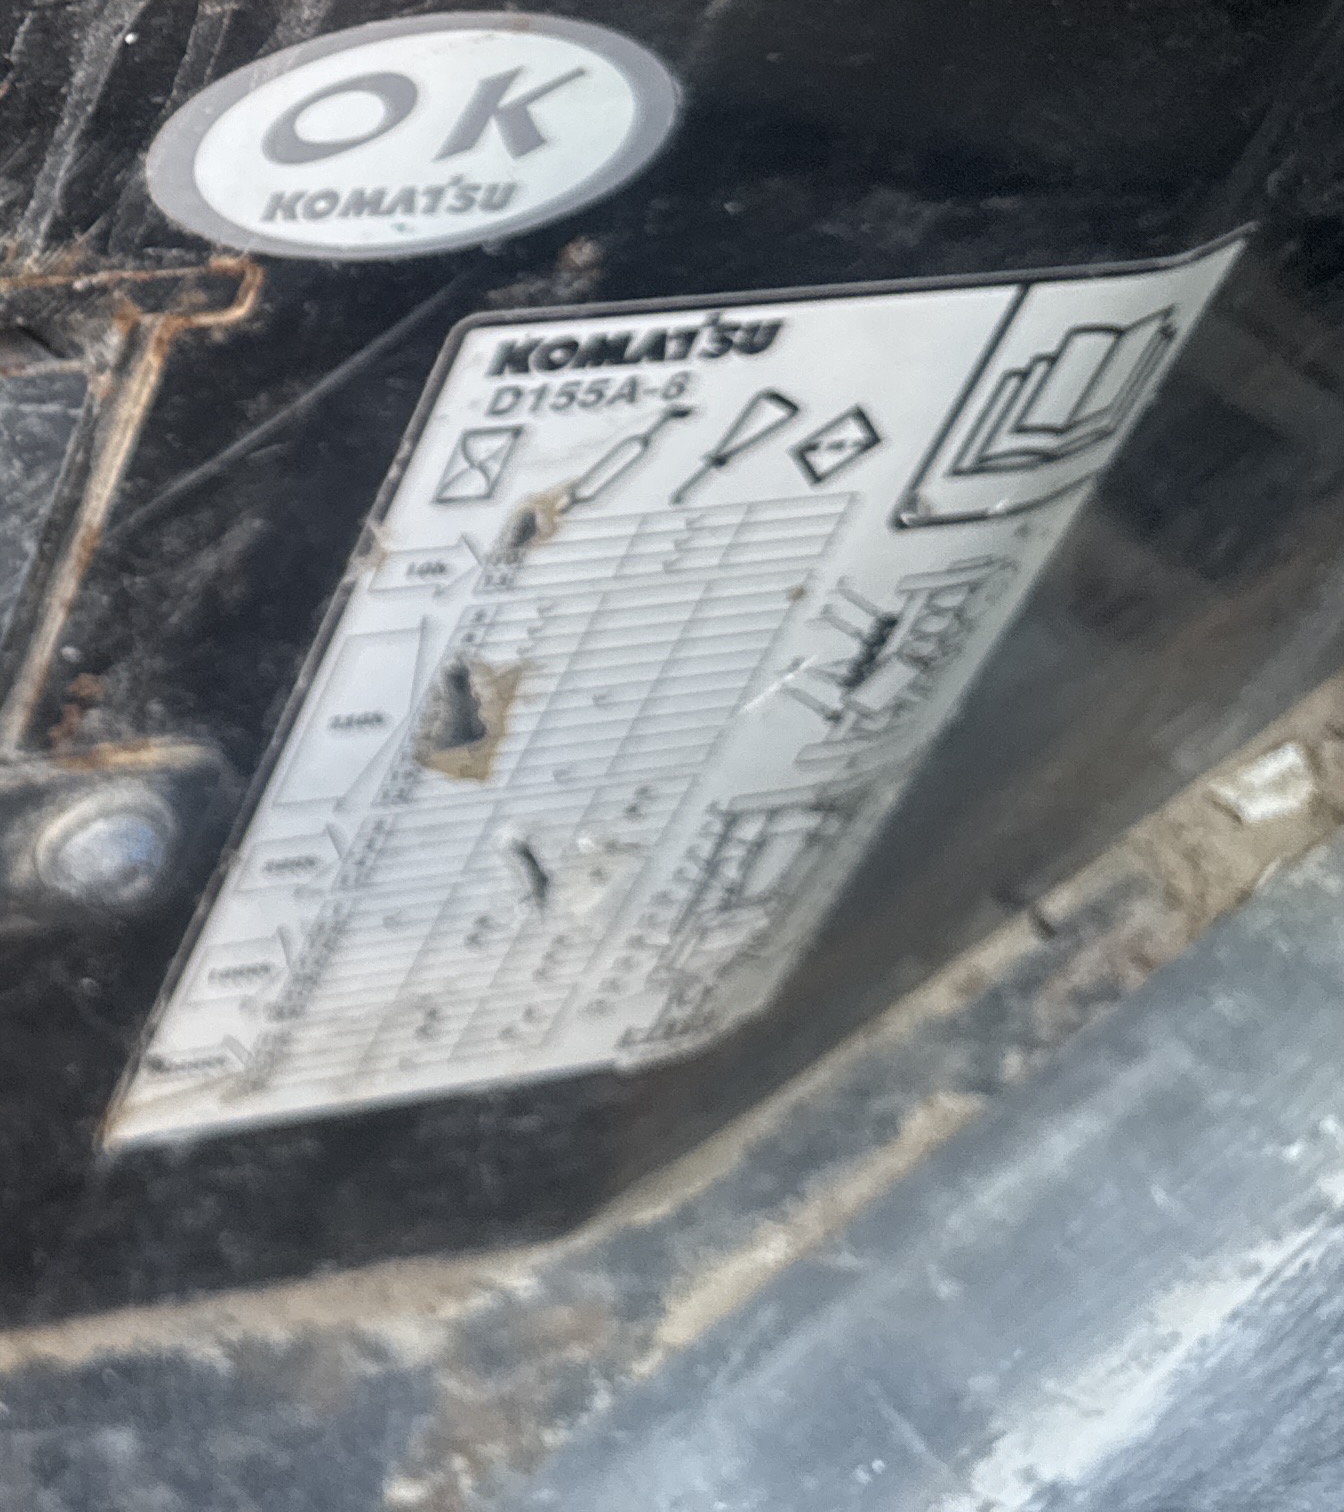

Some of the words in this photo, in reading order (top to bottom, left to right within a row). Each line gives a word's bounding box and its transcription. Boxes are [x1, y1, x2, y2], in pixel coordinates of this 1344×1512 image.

[261, 65, 587, 165] OK
[259, 175, 525, 223] KOMATSU
[486, 311, 784, 377] KOMATSU
